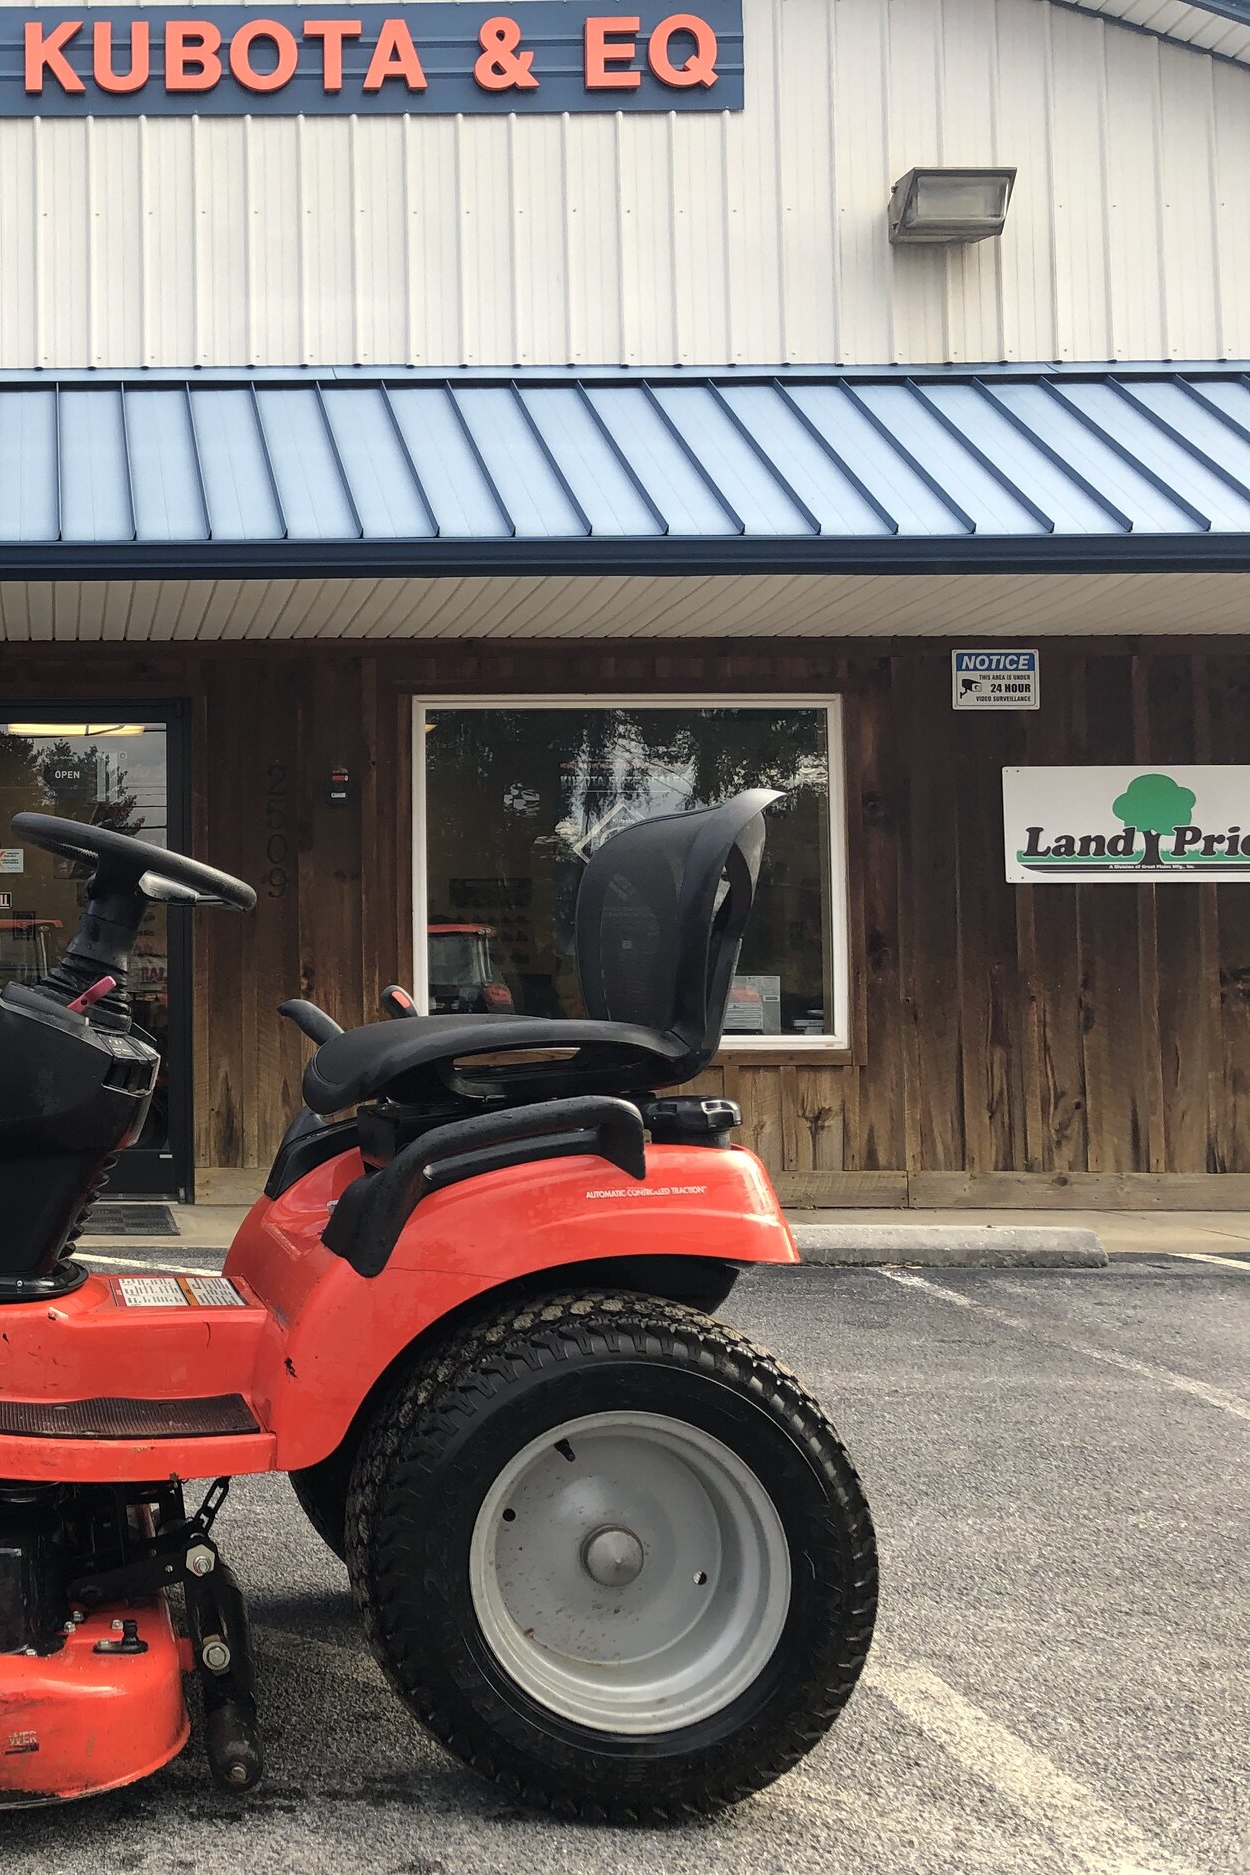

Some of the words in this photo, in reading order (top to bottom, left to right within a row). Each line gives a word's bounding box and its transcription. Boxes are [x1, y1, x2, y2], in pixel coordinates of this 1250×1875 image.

[23, 18, 429, 95] KUBOTA
[472, 16, 541, 92] &
[583, 13, 719, 91] EQ
[961, 655, 1030, 670] NOTICE
[990, 683, 1003, 693] 24
[1004, 683, 1031, 693] HOUR
[54, 770, 81, 780] OPEN
[1022, 826, 1136, 857] Land
[586, 1189, 626, 1199] AUTOMATIC
